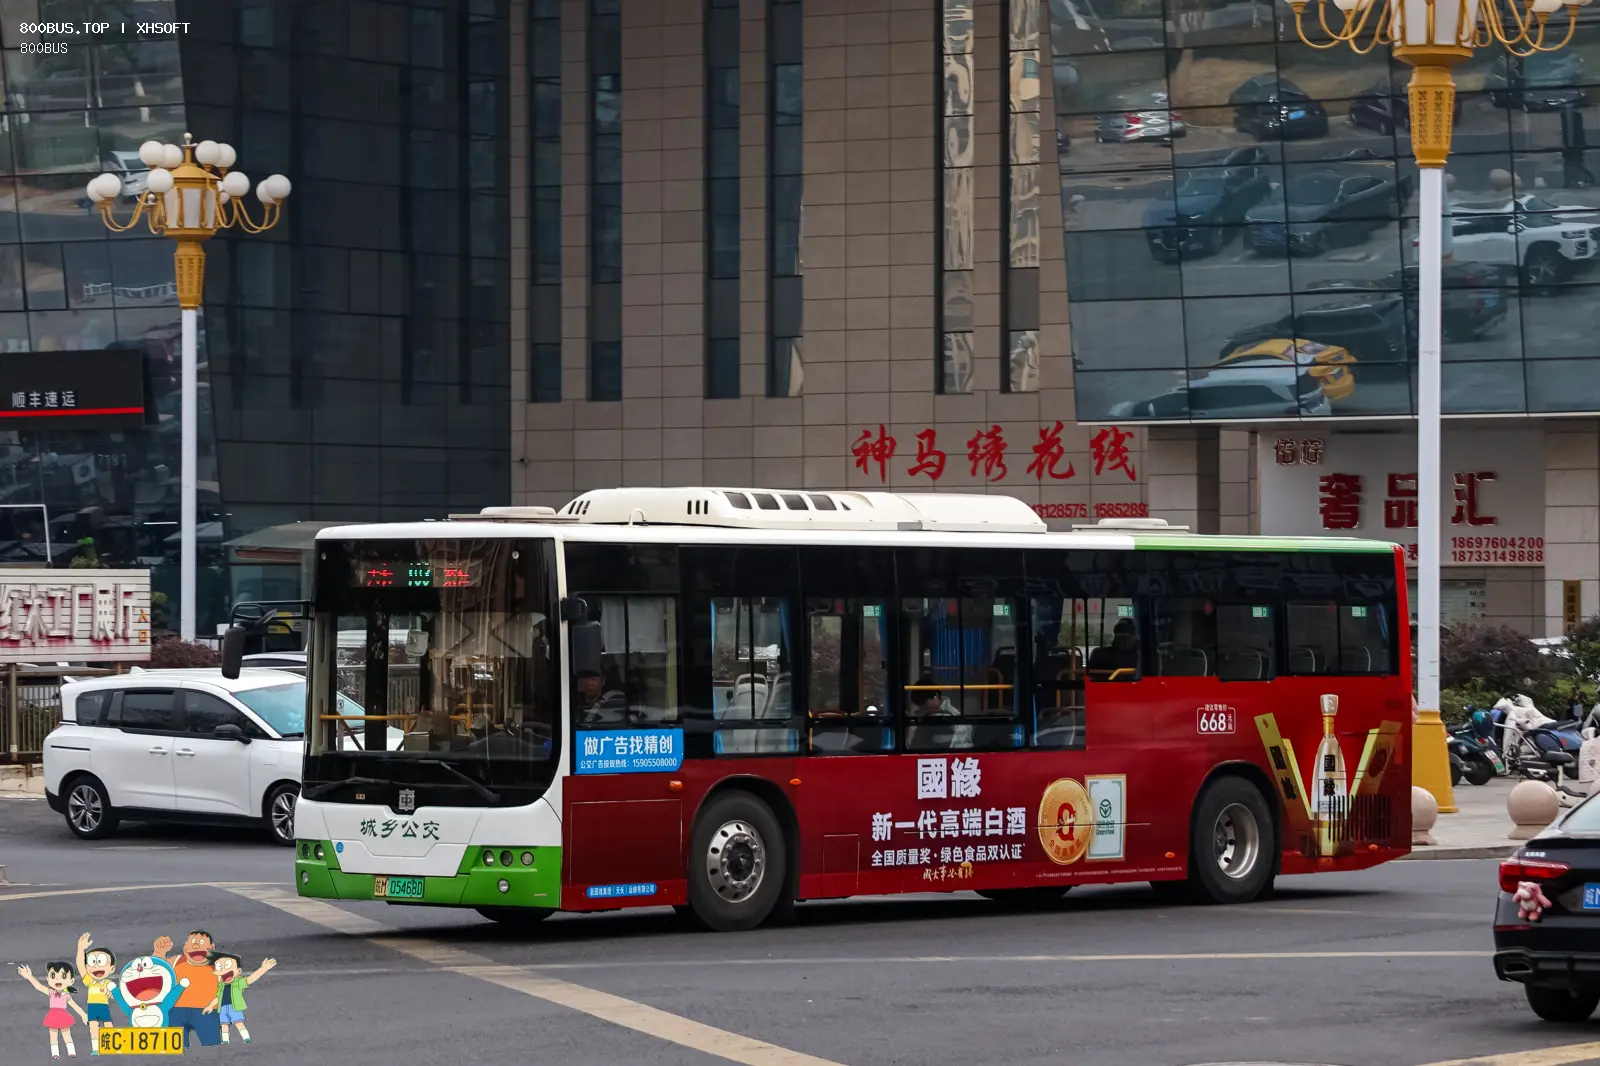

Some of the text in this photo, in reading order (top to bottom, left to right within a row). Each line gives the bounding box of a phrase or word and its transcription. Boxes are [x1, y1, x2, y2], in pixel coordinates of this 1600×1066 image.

[12, 391, 76, 408] 顺丰速运
[851, 420, 1136, 484] 神马绣花线
[1094, 502, 1148, 517] 1585289
[1318, 472, 1497, 530] 奢品汇
[1451, 537, 1544, 549] 18697604200
[1451, 550, 1544, 562] 18733149888
[1200, 712, 1227, 732] 668
[584, 735, 673, 756] 做广告找精创
[632, 758, 678, 768] 15905508000
[917, 757, 982, 800] 國緣
[360, 818, 440, 840] 城乡公交
[872, 807, 1027, 842] 新一代高端白酒
